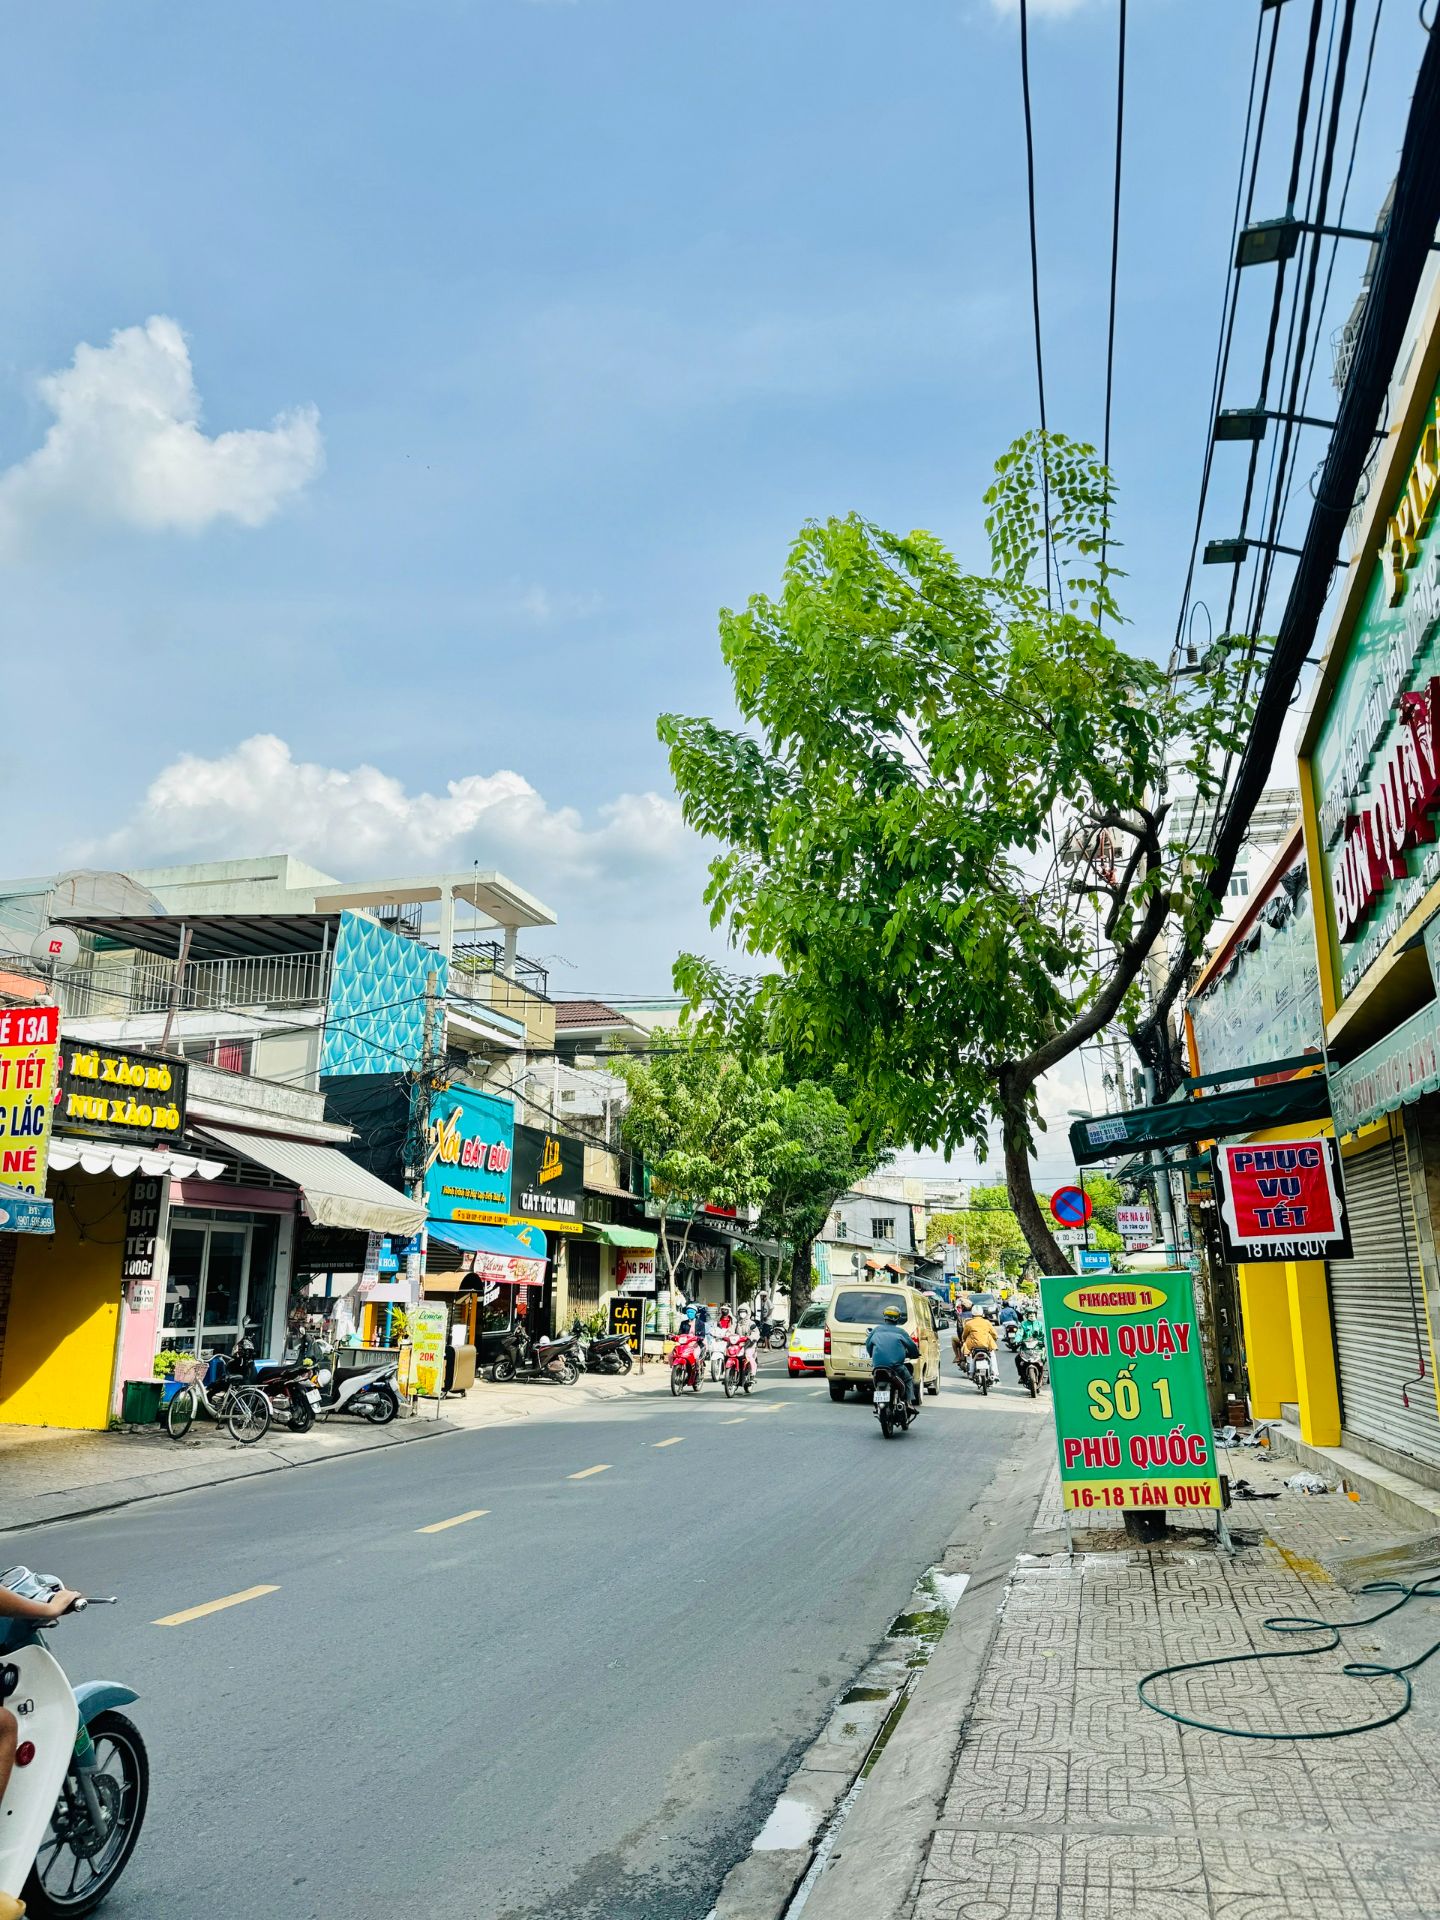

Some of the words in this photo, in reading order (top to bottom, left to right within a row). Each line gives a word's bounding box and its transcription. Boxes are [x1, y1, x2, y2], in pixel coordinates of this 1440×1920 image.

[1396, 396, 1440, 569] PIK
[0, 1012, 11, 1044] É
[17, 1014, 49, 1043] 13A
[16, 1049, 46, 1090] TẾT
[70, 1050, 100, 1079] MÌ
[101, 1057, 146, 1087] XÀO
[146, 1064, 172, 1092] BÒ
[11, 1094, 45, 1137] LẮC
[67, 1093, 109, 1121] NUI
[108, 1097, 153, 1127] XÀO
[152, 1102, 181, 1131] BÒ
[3, 1146, 37, 1172] NÉ
[462, 1135, 487, 1169] BÁT
[1233, 1147, 1321, 1173] PHỤC
[134, 1179, 158, 1200] BÒ
[521, 1184, 539, 1211] CẮT
[540, 1190, 557, 1213] TÓC
[556, 1198, 576, 1216] NAM
[1257, 1176, 1302, 1200] VỤ
[129, 1207, 157, 1227] BÍT
[1252, 1199, 1309, 1229] TẾT
[126, 1231, 156, 1255] TẾT
[1245, 1241, 1262, 1258] 18
[124, 1259, 153, 1276] 100Gr
[639, 1259, 653, 1274] PHÚ
[614, 1303, 638, 1319] CẮT
[1078, 1291, 1137, 1307] PIKACHU
[1139, 1290, 1153, 1306] 11
[614, 1321, 637, 1335] TÓC
[1051, 1322, 1111, 1357] BÚN
[1117, 1318, 1191, 1360] QUẬY
[419, 1352, 435, 1362] 20K
[1087, 1363, 1142, 1421] SỐ
[1152, 1377, 1174, 1420] 1
[1063, 1430, 1122, 1469] PHÚ
[1129, 1424, 1208, 1470] QUỐC
[1070, 1486, 1125, 1508] 16-18
[1130, 1484, 1169, 1506] TÂN
[1174, 1482, 1212, 1507] QUÝ
